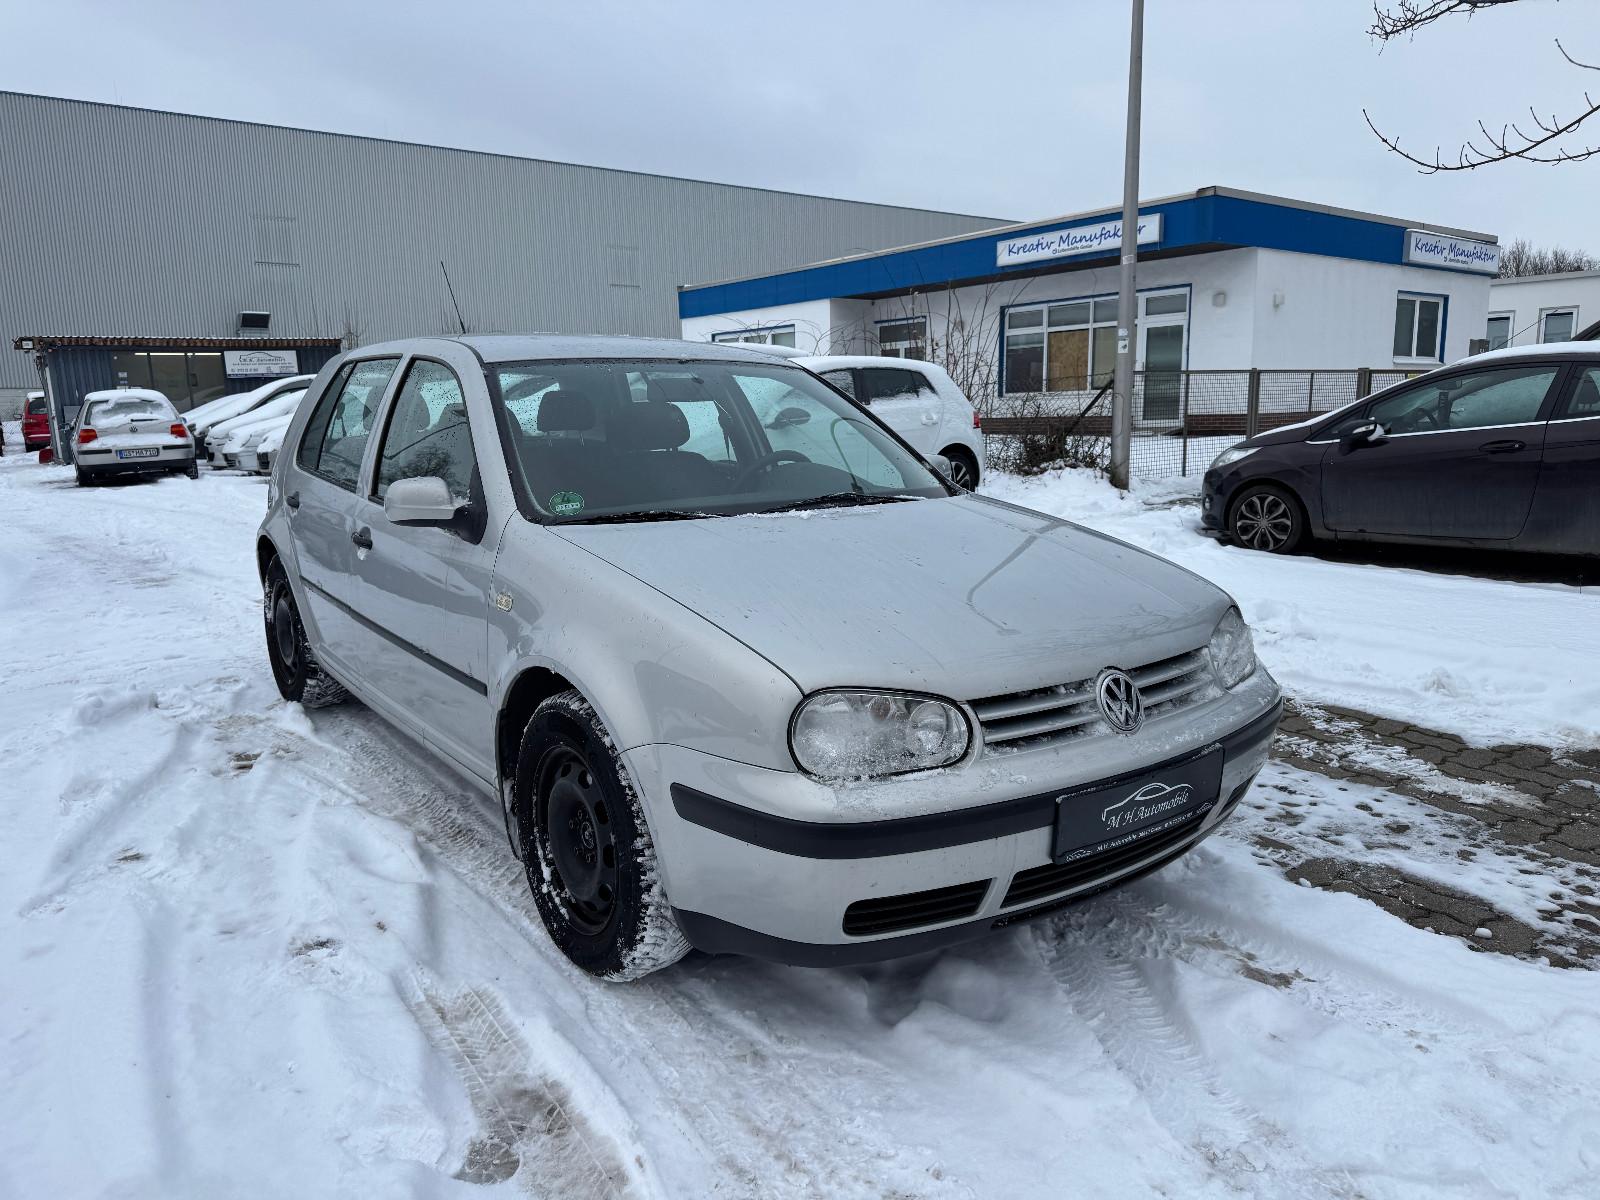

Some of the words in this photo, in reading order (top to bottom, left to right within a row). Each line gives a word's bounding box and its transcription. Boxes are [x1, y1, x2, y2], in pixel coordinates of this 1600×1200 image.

[1008, 236, 1056, 257] Kreativ
[1058, 223, 1146, 247] Manufakr
[1414, 237, 1446, 256] Kreativ
[1448, 242, 1496, 264] Manufaktur
[1107, 811, 1124, 831] M
[1123, 807, 1137, 826] H
[1134, 788, 1189, 820] Automobile
